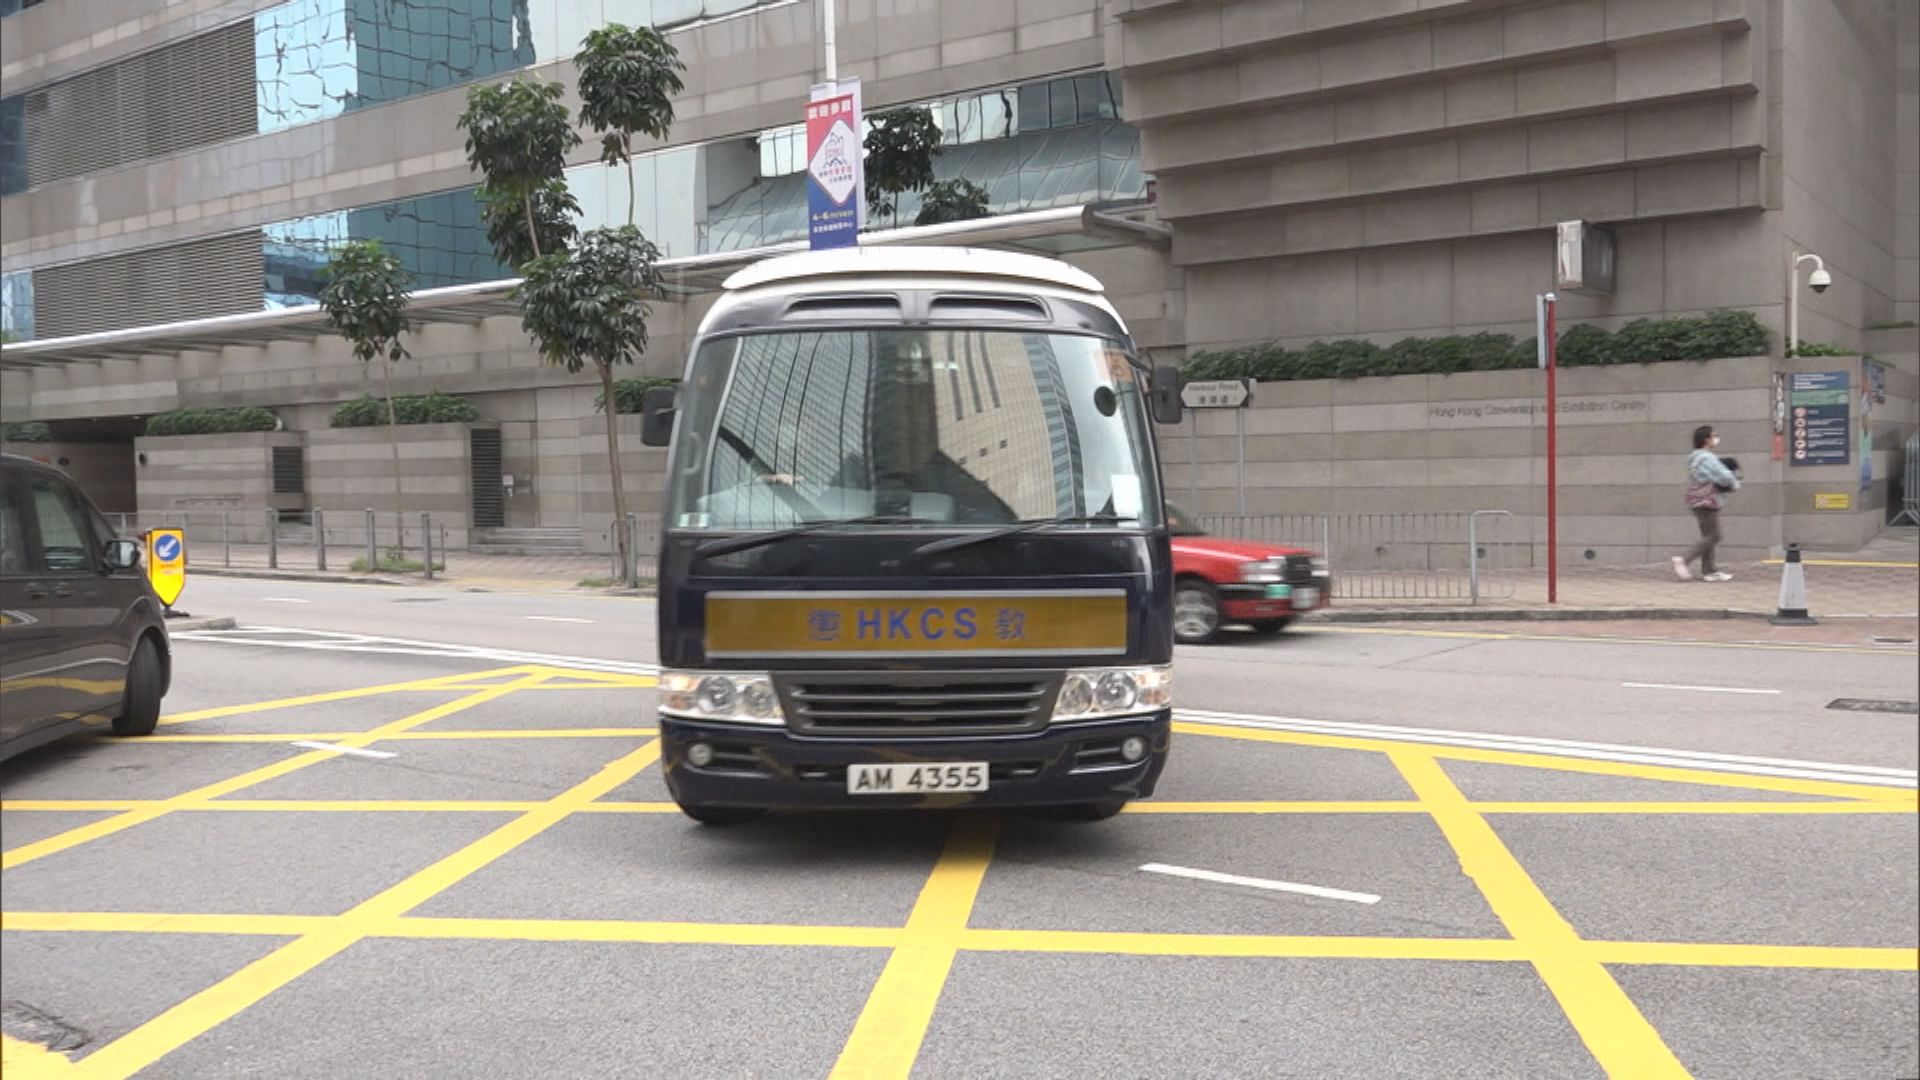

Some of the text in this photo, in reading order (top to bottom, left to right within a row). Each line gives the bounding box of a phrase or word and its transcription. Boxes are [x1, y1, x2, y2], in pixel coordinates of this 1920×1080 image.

[1429, 407, 1456, 418] Hong
[1457, 407, 1482, 417] Kong
[856, 607, 977, 640] HKCS
[856, 766, 982, 790] AM 4355
